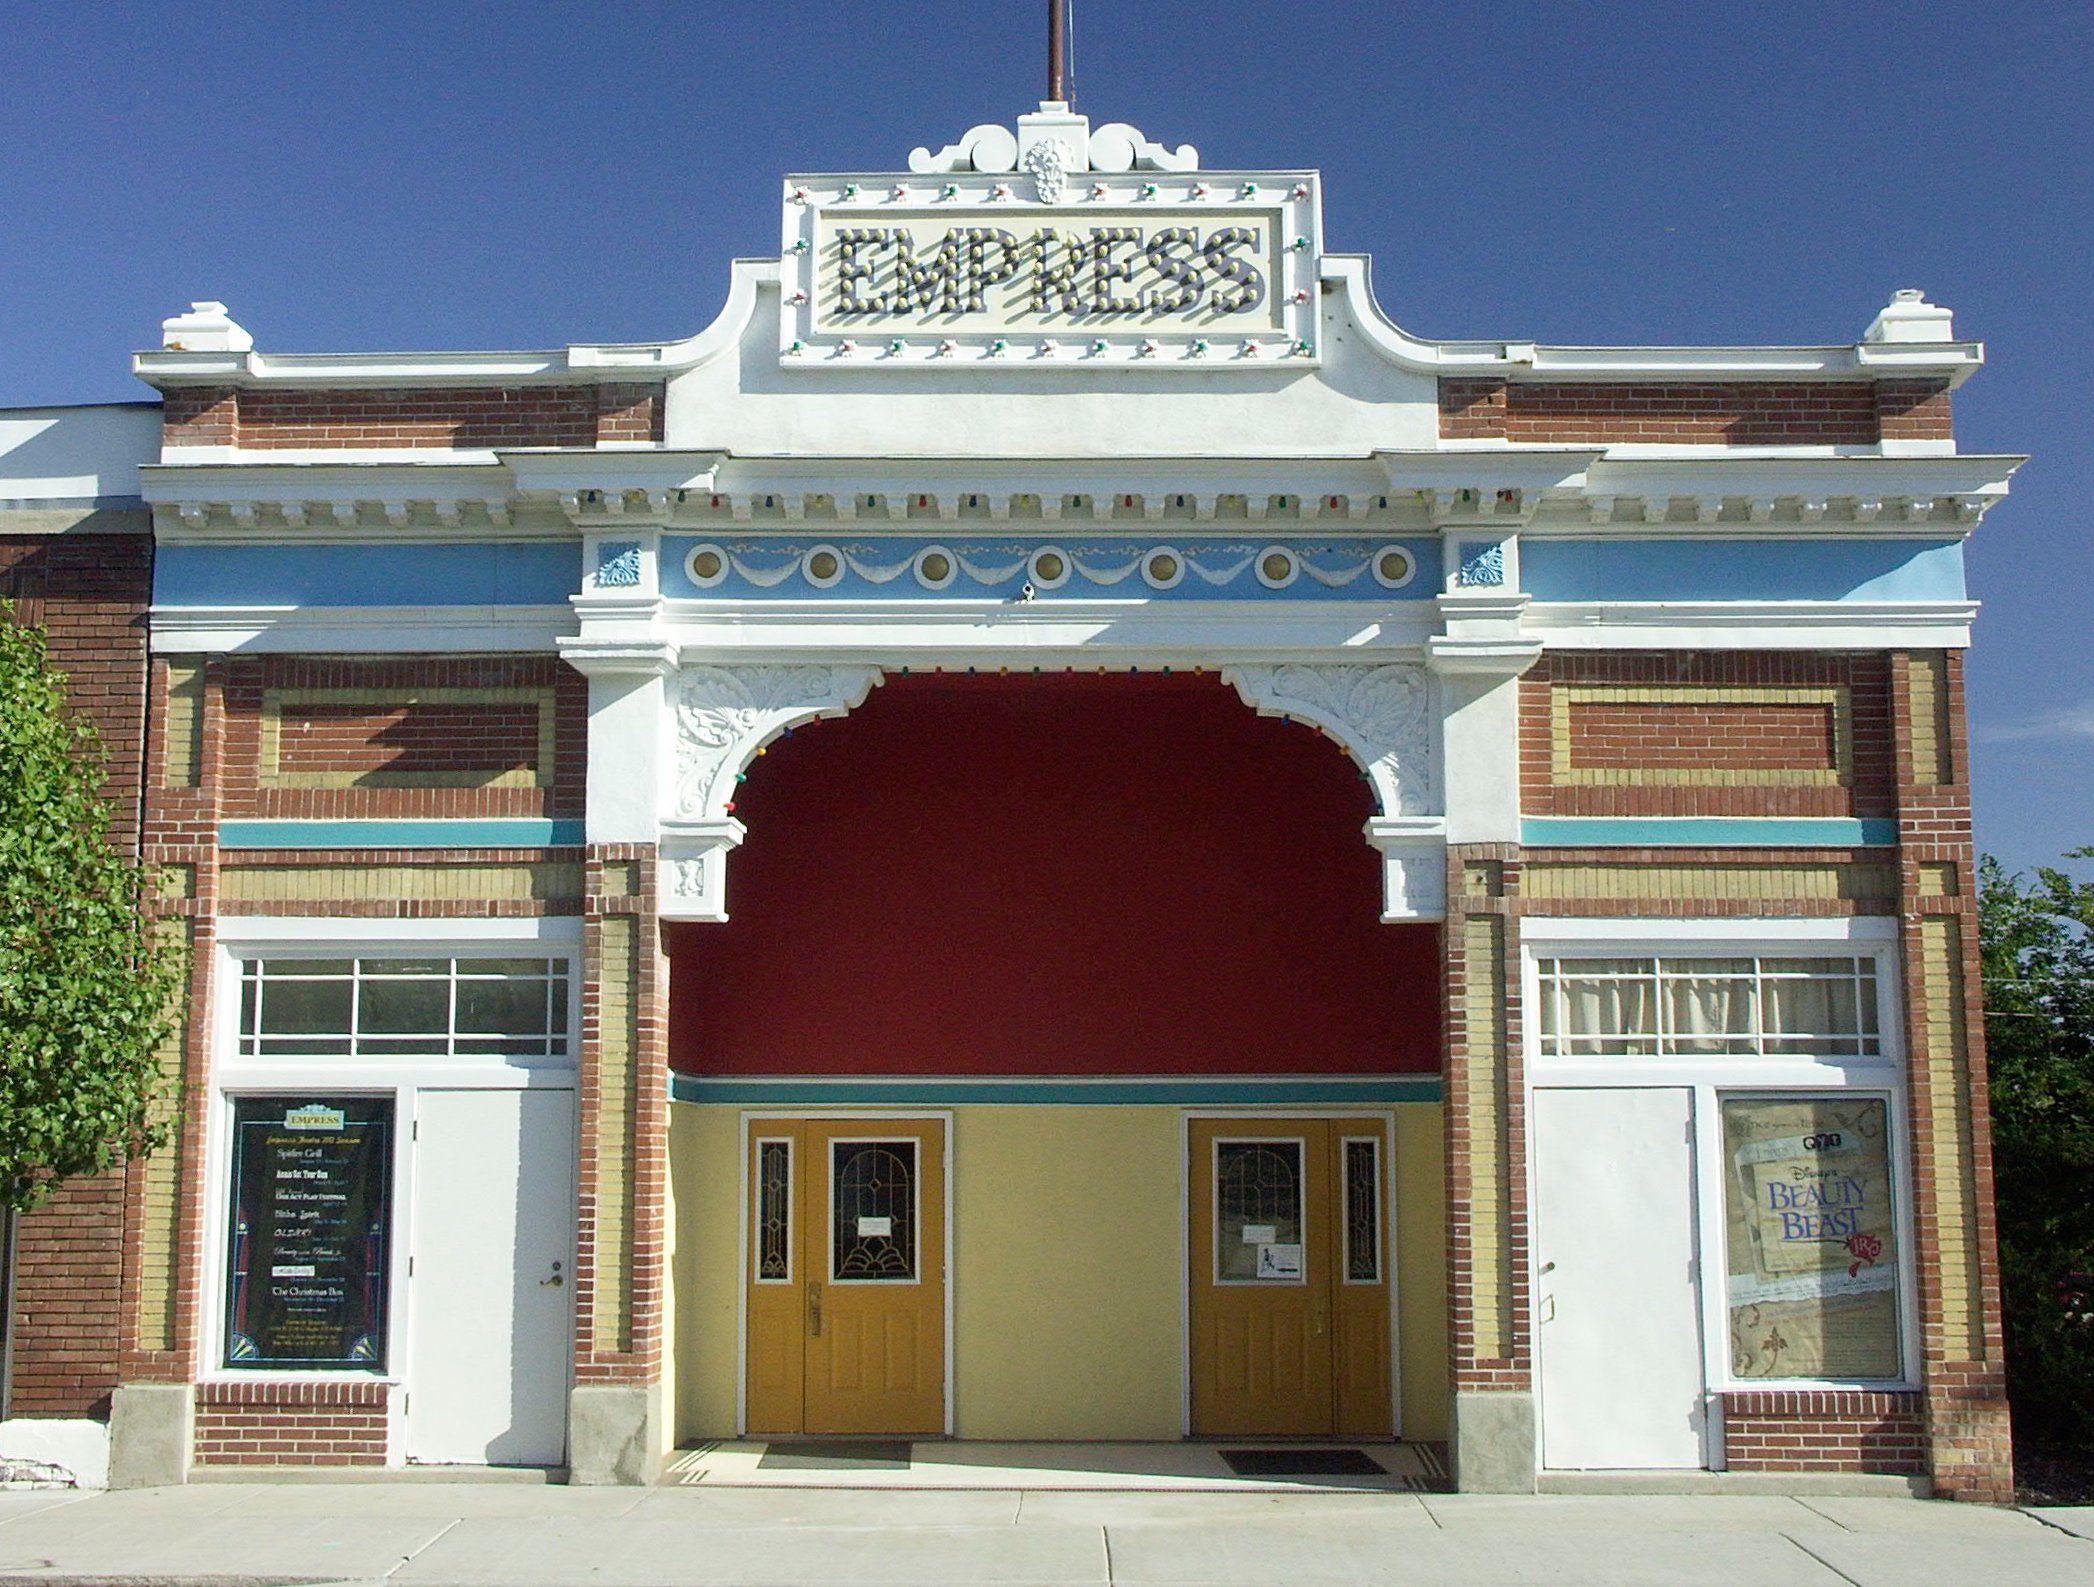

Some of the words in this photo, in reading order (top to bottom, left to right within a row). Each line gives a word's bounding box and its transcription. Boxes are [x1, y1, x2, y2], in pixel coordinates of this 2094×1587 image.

[833, 226, 1266, 315] EMPRESS
[291, 1115, 340, 1124] EMPRESS
[1767, 1176, 1868, 1210] BEAUTY
[1779, 1206, 1864, 1240] BEAST
